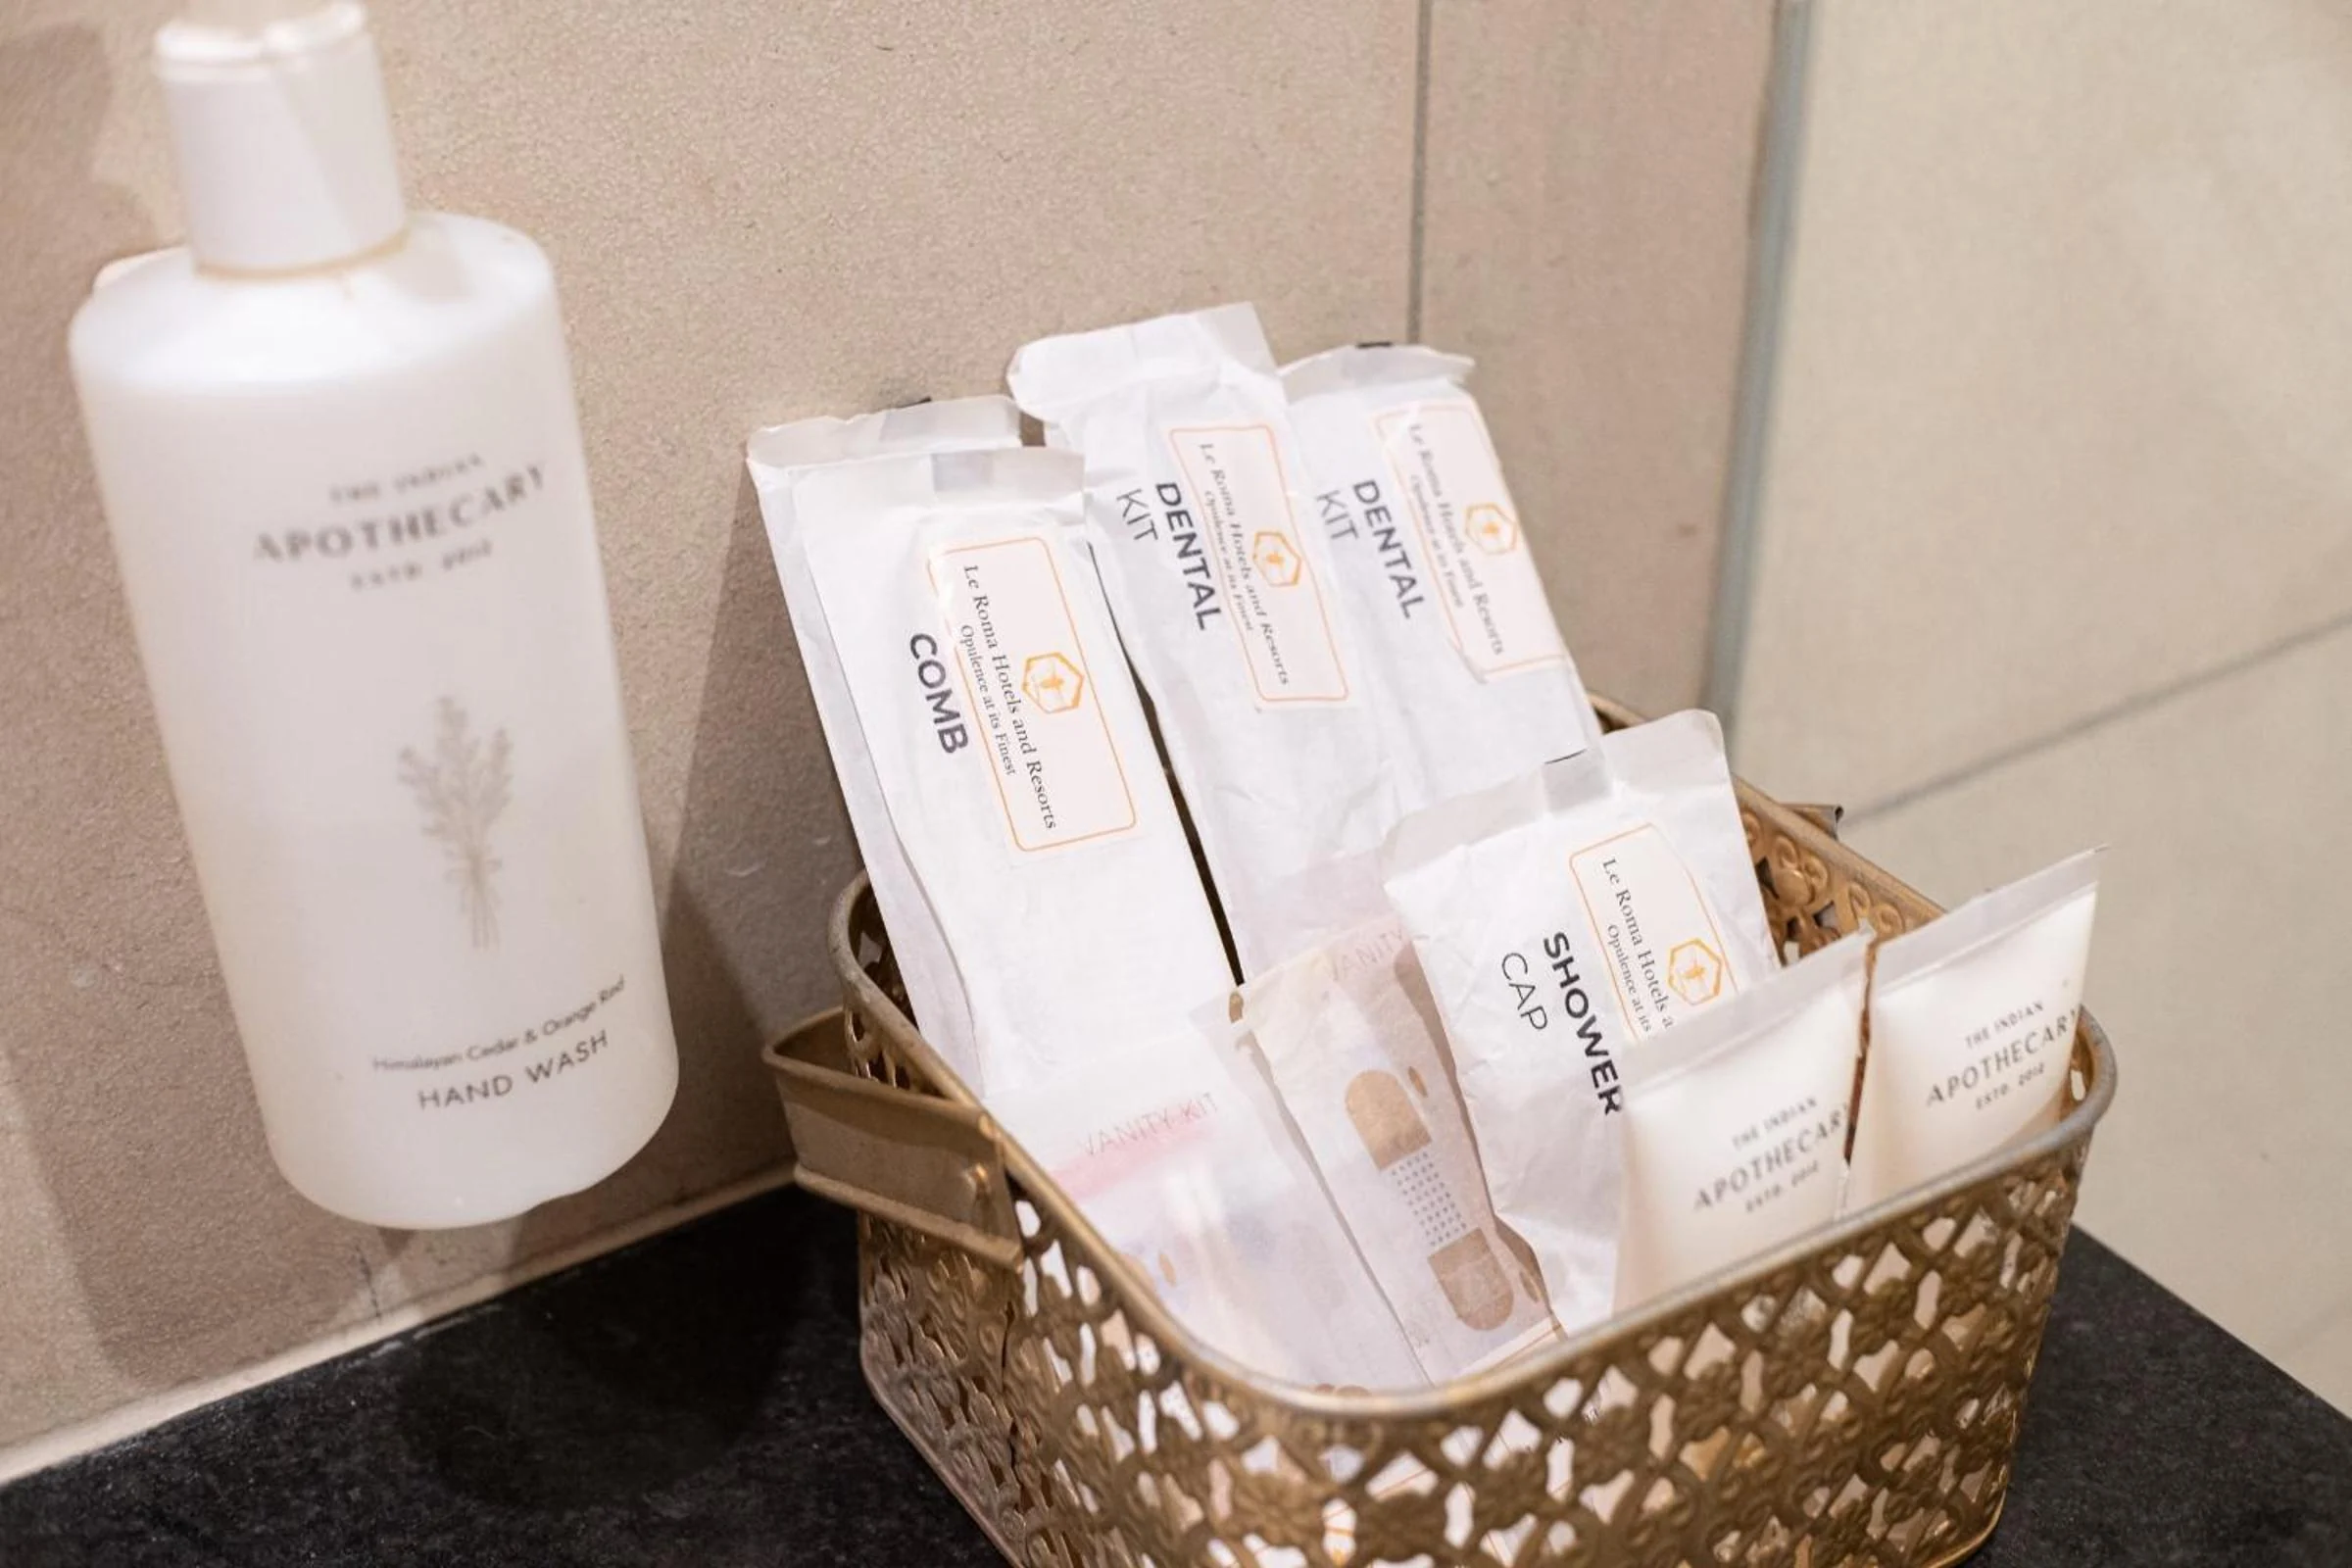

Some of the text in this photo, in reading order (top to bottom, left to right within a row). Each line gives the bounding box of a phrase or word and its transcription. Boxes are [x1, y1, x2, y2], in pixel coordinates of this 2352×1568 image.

[253, 461, 546, 564] APOTHECARY
[1116, 489, 1158, 540] KIT
[1156, 482, 1222, 630] DENTAL
[1200, 443, 1289, 685] Le Roma Hotels and Resorts
[1316, 490, 1359, 539] KIT
[1352, 479, 1424, 619] DENTAL
[1459, 557, 1484, 591] and
[1474, 594, 1503, 655] Resorts
[909, 633, 968, 754] COMB
[961, 623, 1015, 775] Opulence at its Finest
[963, 564, 1056, 829] Le Roma Hotels and Resorts
[1602, 858, 1620, 885] Le
[1616, 889, 1643, 947] Roma
[1639, 950, 1670, 1012] Hotels
[1607, 924, 1653, 1033] Opulence at its
[542, 1001, 596, 1036] Orange
[1501, 952, 1547, 1031] CAP
[1544, 932, 1624, 1115] SHOWER
[1965, 1000, 2044, 1051] THE INDIAN
[416, 1029, 610, 1110] HAND WASH
[1078, 1092, 1218, 1156] VANITY KIT
